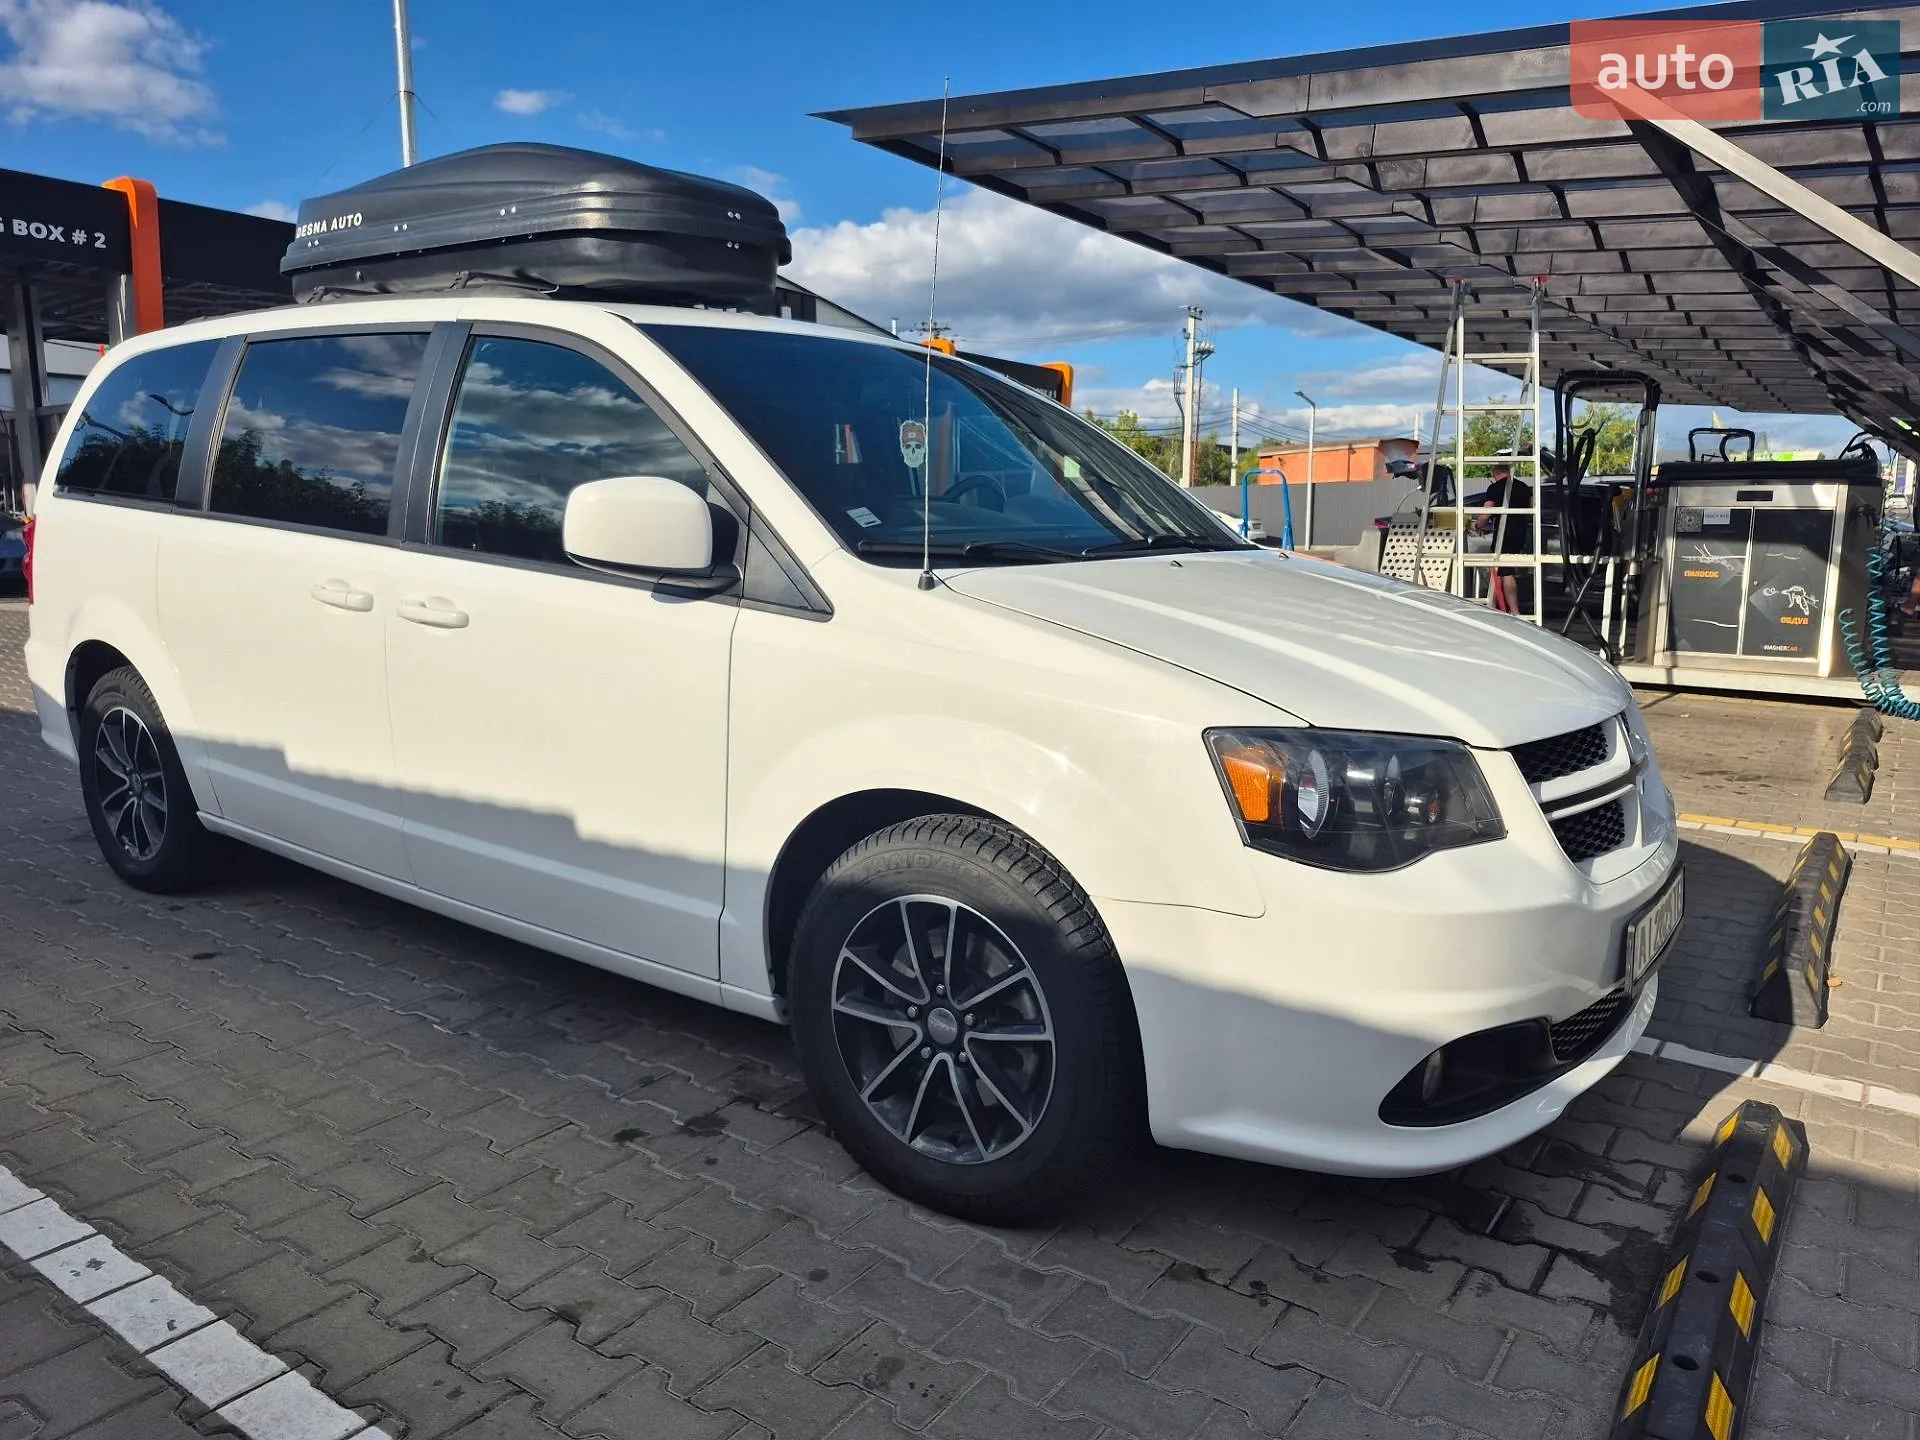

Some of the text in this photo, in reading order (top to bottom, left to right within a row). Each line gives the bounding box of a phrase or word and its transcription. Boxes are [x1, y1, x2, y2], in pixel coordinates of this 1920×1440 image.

[12, 218, 66, 243] BOX
[71, 228, 88, 245] #
[94, 231, 107, 249] 2
[330, 212, 363, 231] AUTO
